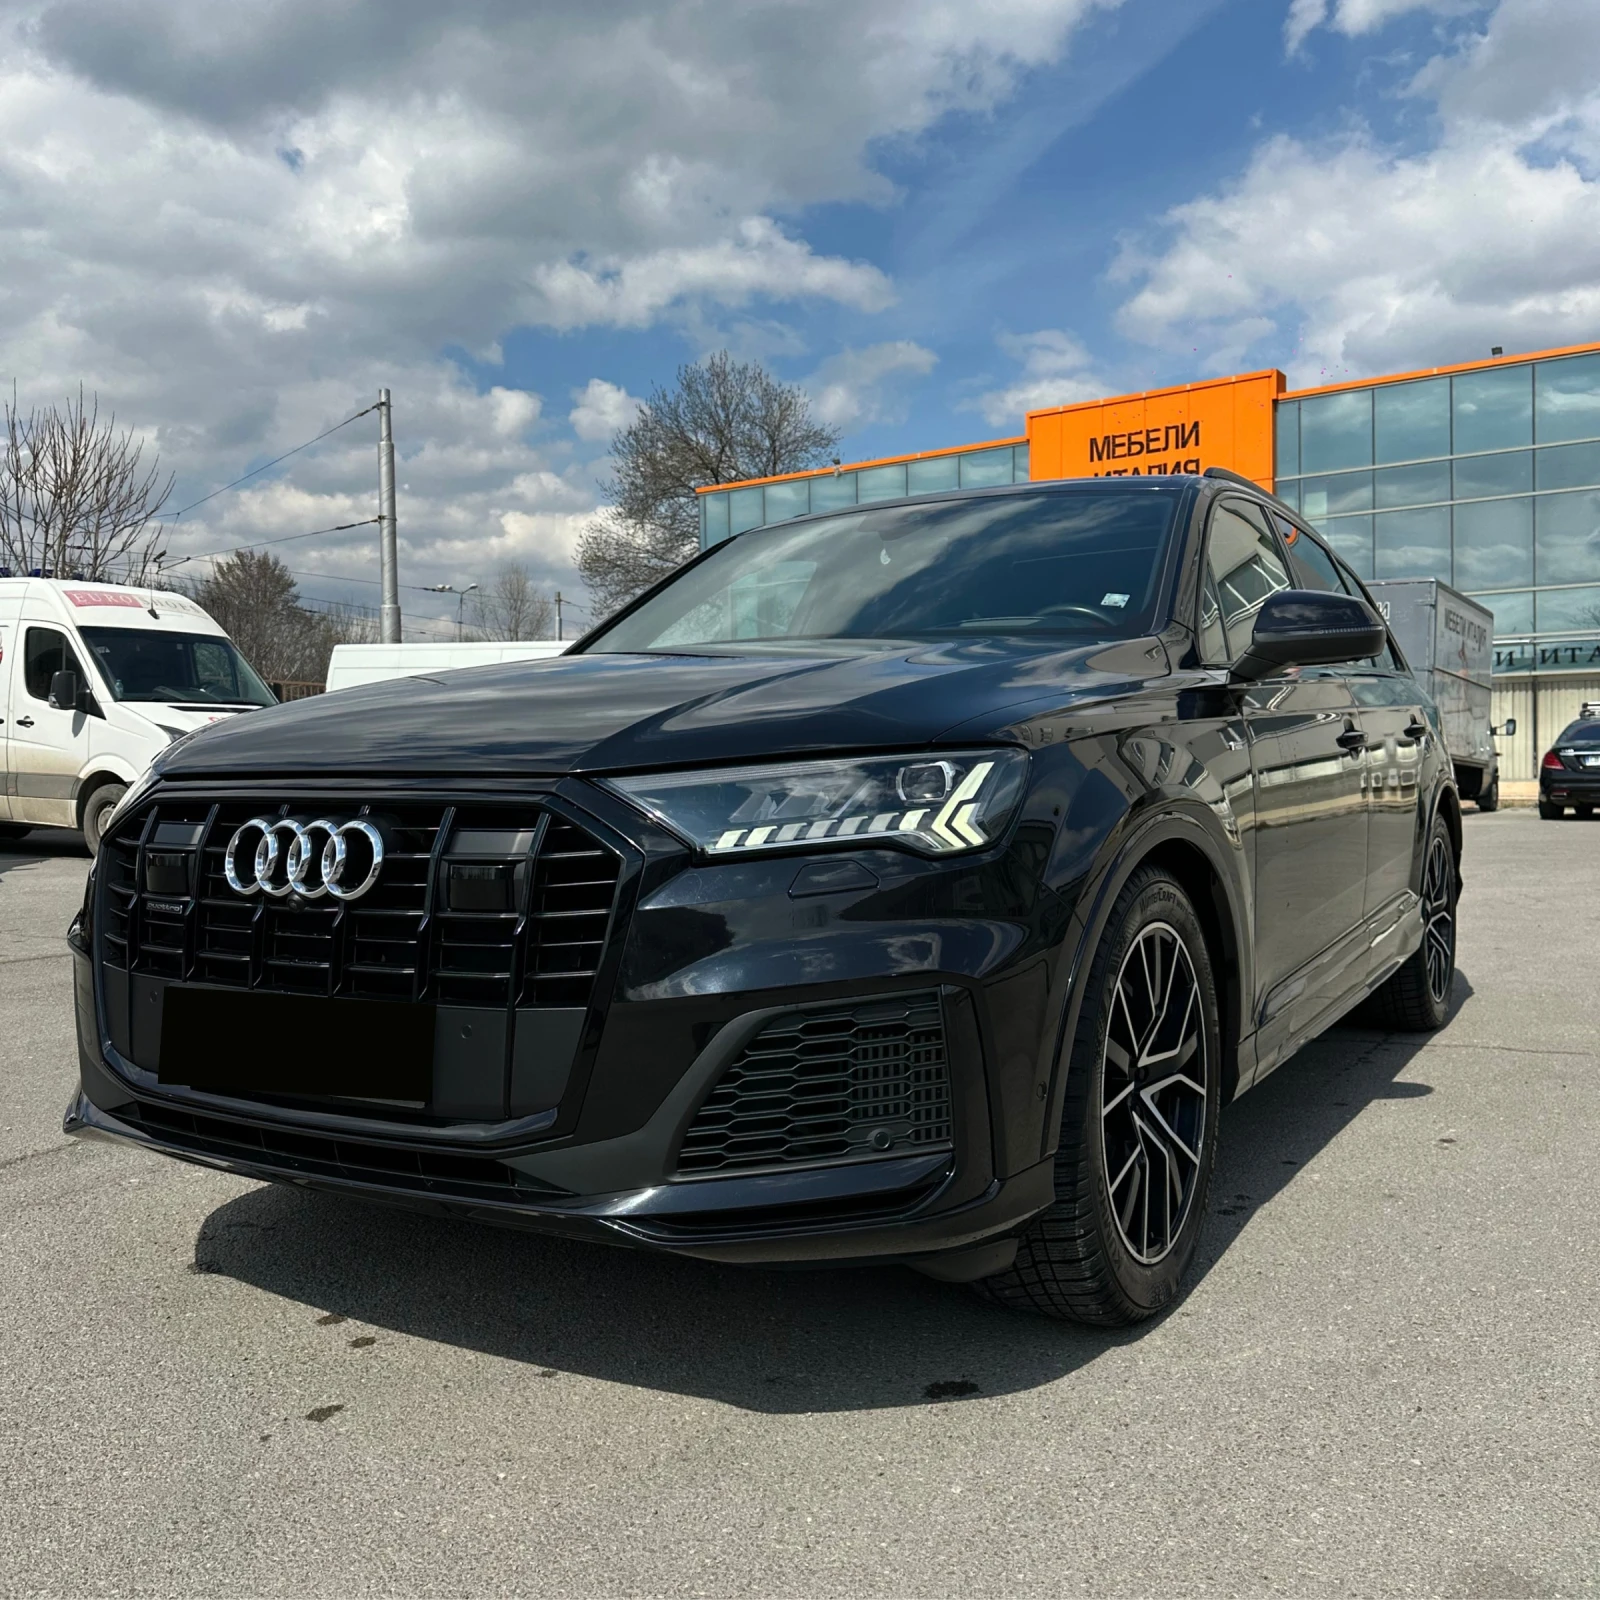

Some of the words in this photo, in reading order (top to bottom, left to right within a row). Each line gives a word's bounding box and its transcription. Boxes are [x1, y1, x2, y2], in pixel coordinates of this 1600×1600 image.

[1089, 420, 1200, 463] МЕБЕЛИ
[72, 592, 133, 605] EURO
[147, 902, 181, 912] quattro
